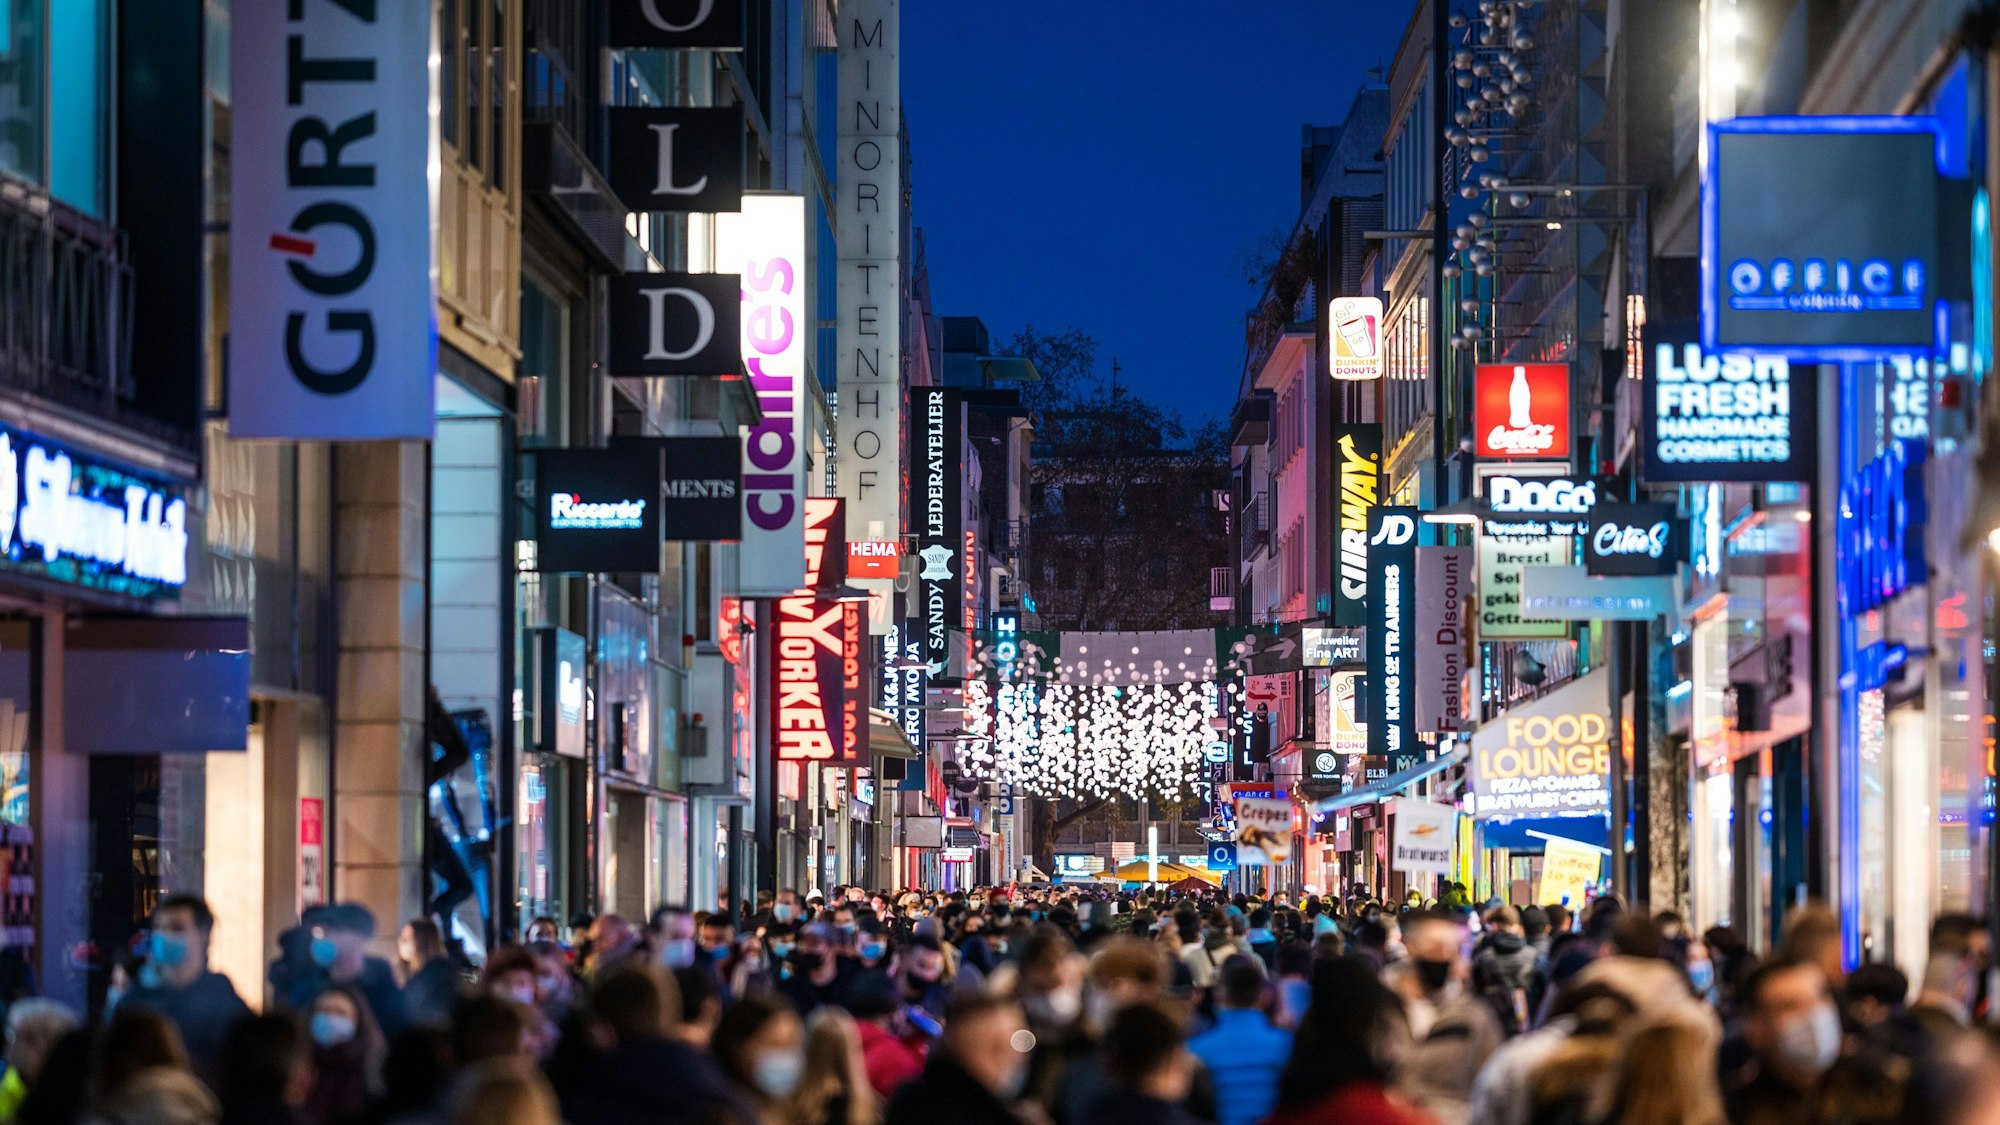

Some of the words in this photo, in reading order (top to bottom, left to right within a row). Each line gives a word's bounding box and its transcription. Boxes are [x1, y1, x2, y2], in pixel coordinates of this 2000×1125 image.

[854, 19, 882, 501] MINORITENHOF
[1336, 358, 1380, 367] DUNKIN'
[1336, 366, 1377, 375] DONUTS
[1656, 343, 1790, 382] LUSH
[1656, 382, 1790, 417] FRESH
[1656, 416, 1790, 439] HANDMADE
[928, 391, 944, 537] LEDERATELIER
[1656, 439, 1791, 463] COSMETICS
[551, 492, 641, 519] Riccardo
[1371, 515, 1414, 546] JD
[851, 542, 897, 557] HEMA
[1497, 552, 1550, 563] Brezel
[1384, 564, 1401, 656] TRAINERS
[1436, 555, 1458, 646] Discount
[929, 583, 944, 649] SANDY
[1306, 647, 1332, 659] Fine
[1334, 647, 1360, 659] ART
[1316, 635, 1360, 646] Juwelier
[1384, 675, 1401, 720] KING
[1437, 653, 1458, 732] Fashion
[906, 709, 920, 747] ERO
[1336, 733, 1367, 741] DUNK
[1506, 712, 1607, 748] FOOD
[1336, 741, 1367, 749] DONU
[1480, 743, 1610, 781] LOUNGE
[1398, 846, 1450, 862] Bratwurst
[1549, 856, 1593, 871] Coffee
